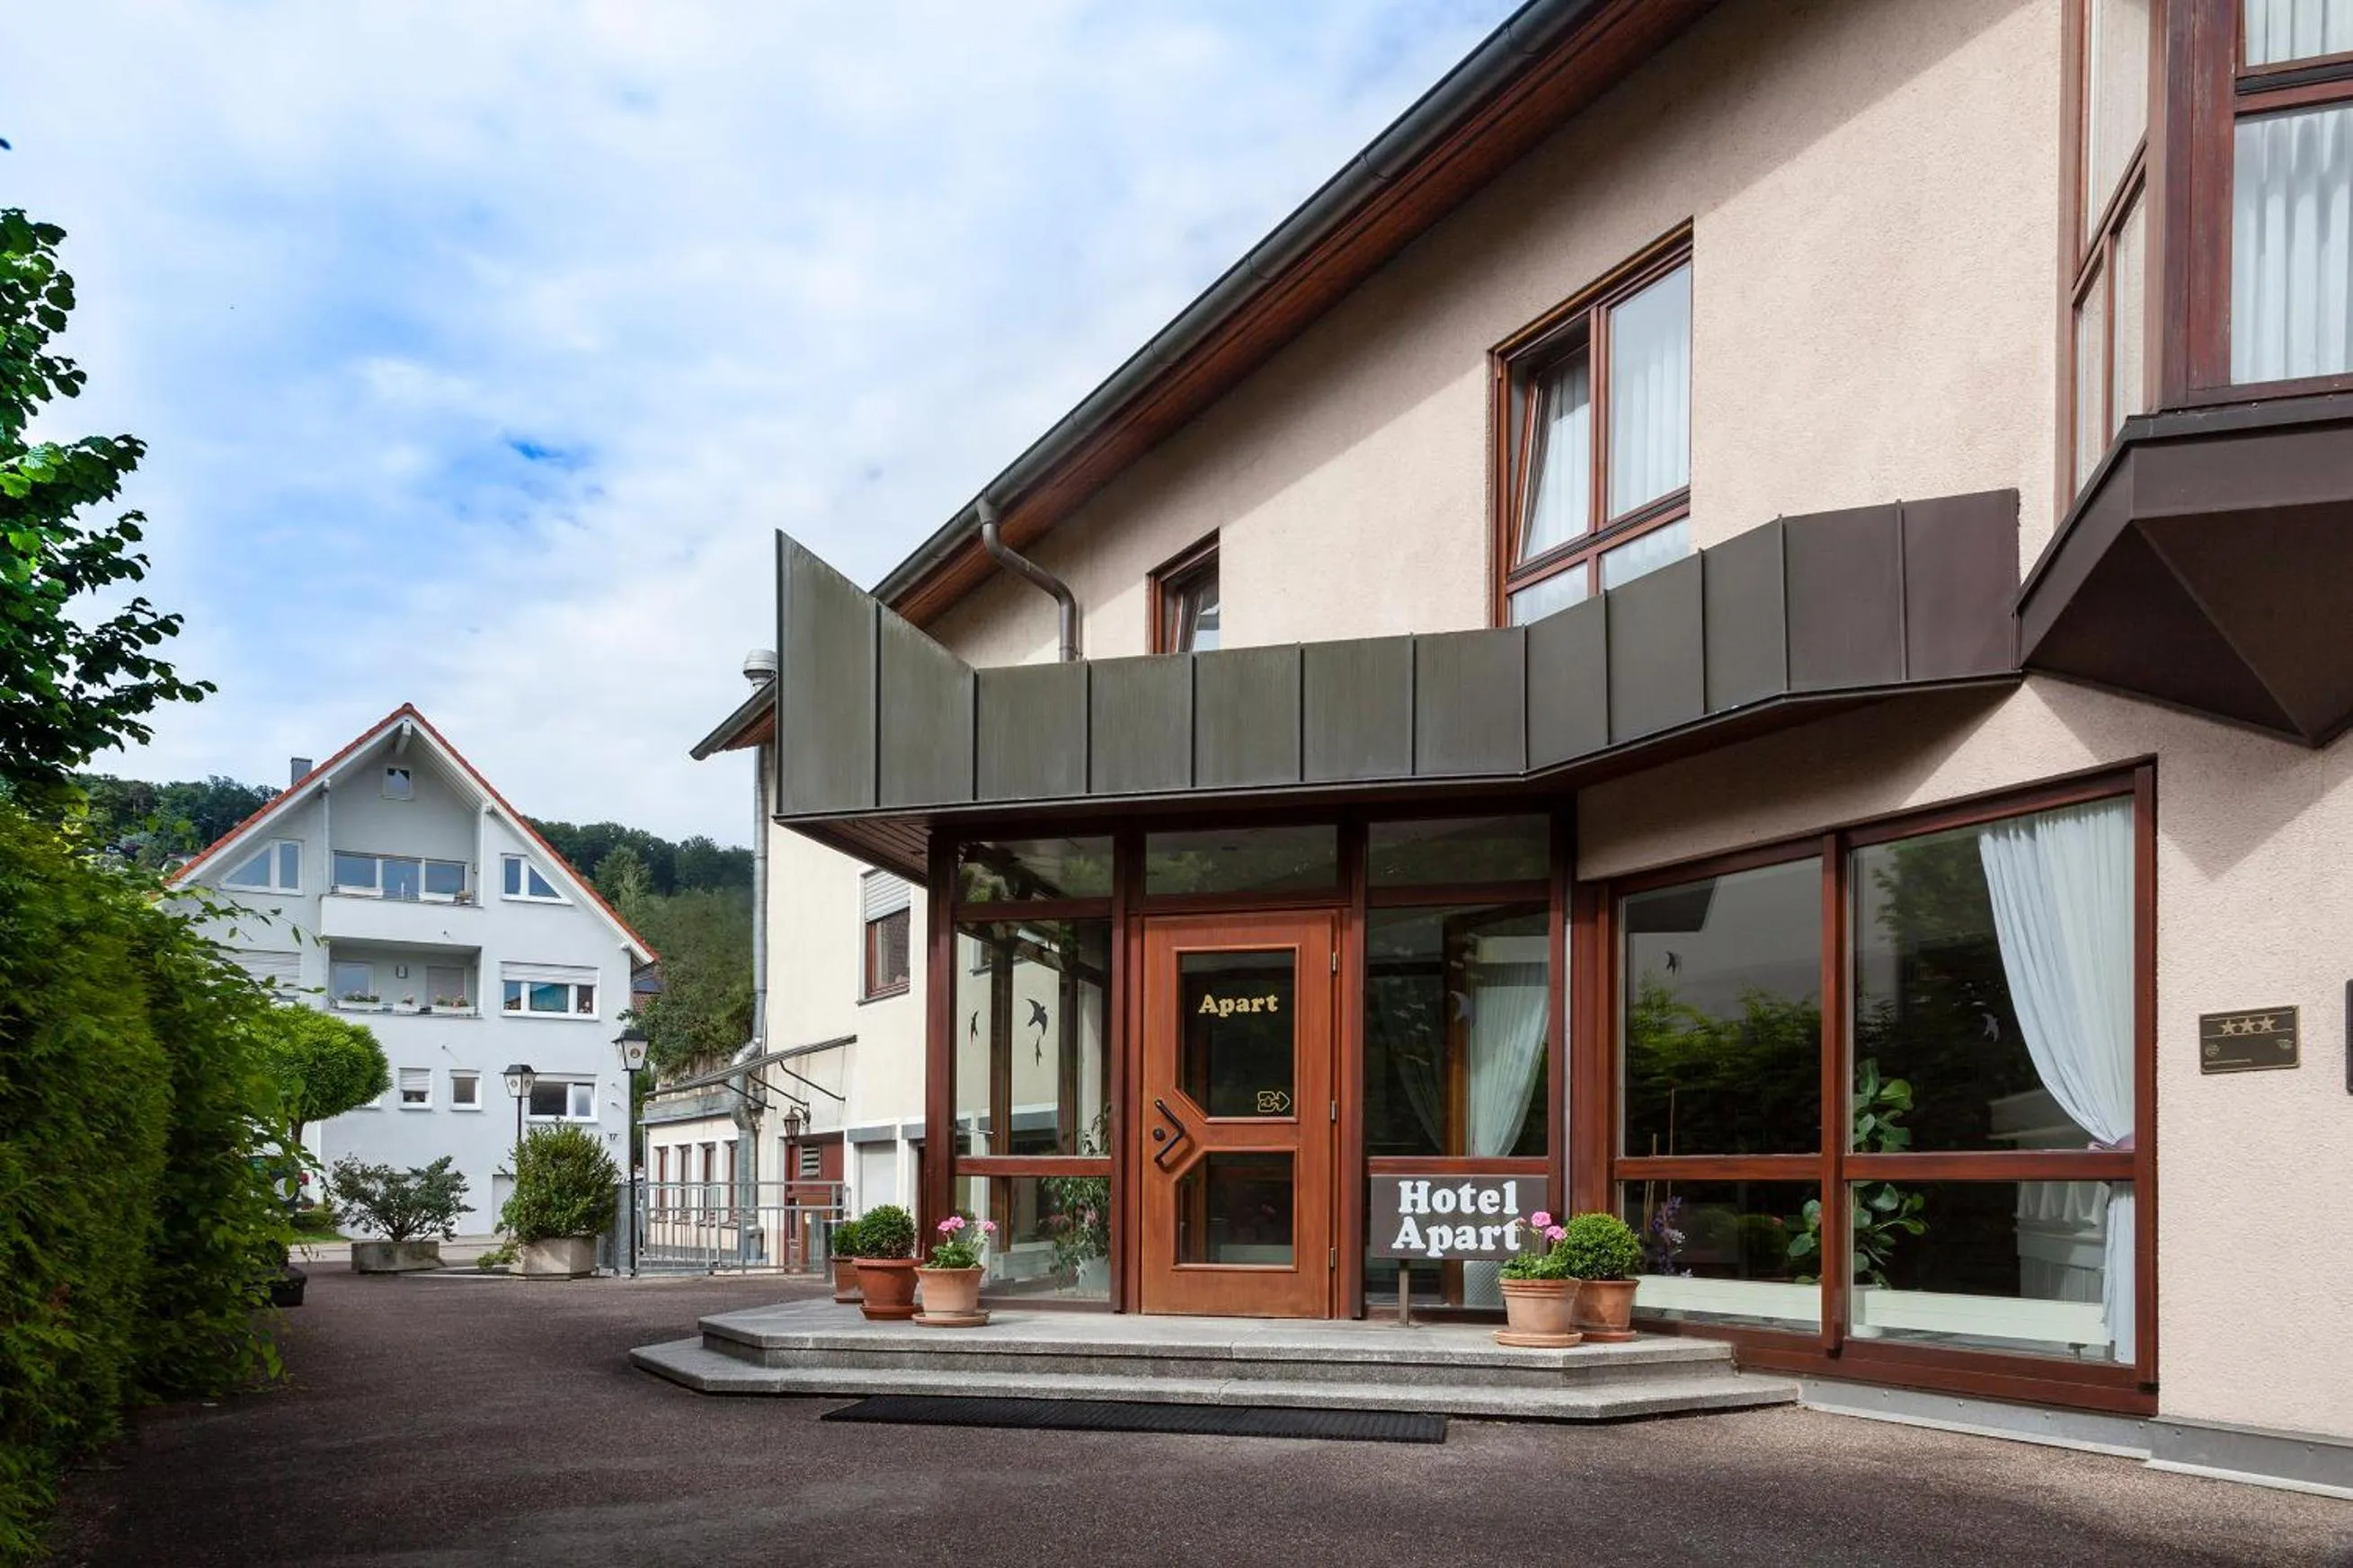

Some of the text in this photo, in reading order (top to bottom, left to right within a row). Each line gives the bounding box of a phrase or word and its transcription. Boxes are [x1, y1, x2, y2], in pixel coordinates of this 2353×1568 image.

[1198, 994, 1278, 1017] Apart
[1398, 1180, 1519, 1214] Hotel
[1391, 1216, 1521, 1257] Apart
